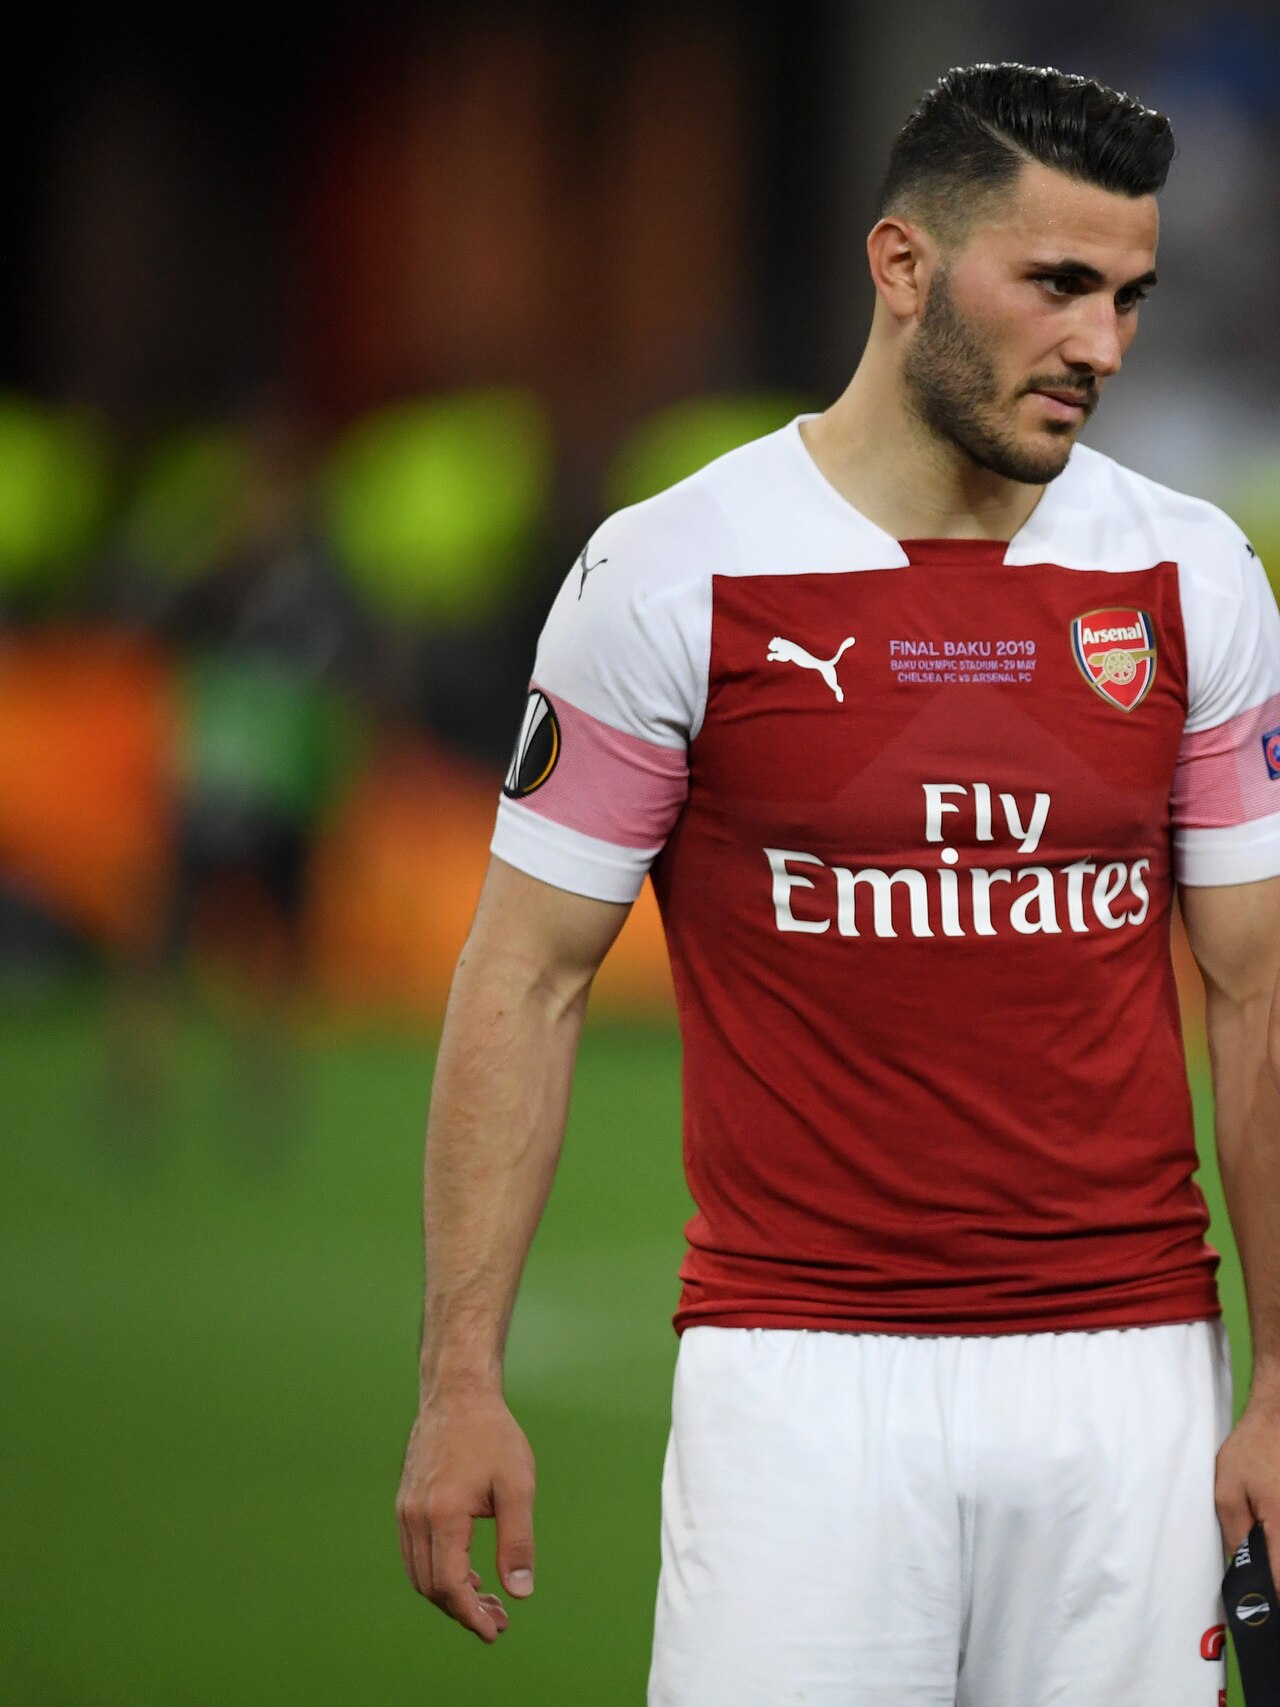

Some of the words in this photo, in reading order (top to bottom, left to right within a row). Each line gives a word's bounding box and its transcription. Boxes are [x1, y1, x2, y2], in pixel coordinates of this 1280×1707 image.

[1082, 622, 1142, 645] Arsenal
[889, 639, 940, 656] FINAL
[944, 640, 991, 656] BAKU
[995, 639, 1036, 656] 2019
[890, 659, 916, 671] BAKU
[917, 659, 958, 671] OLYMPIC
[1016, 659, 1037, 671] MAY
[897, 672, 943, 683] CHELSEA
[972, 672, 1017, 683] ARSENAL
[921, 782, 1051, 854] Fly
[762, 846, 1152, 938] Emirates
